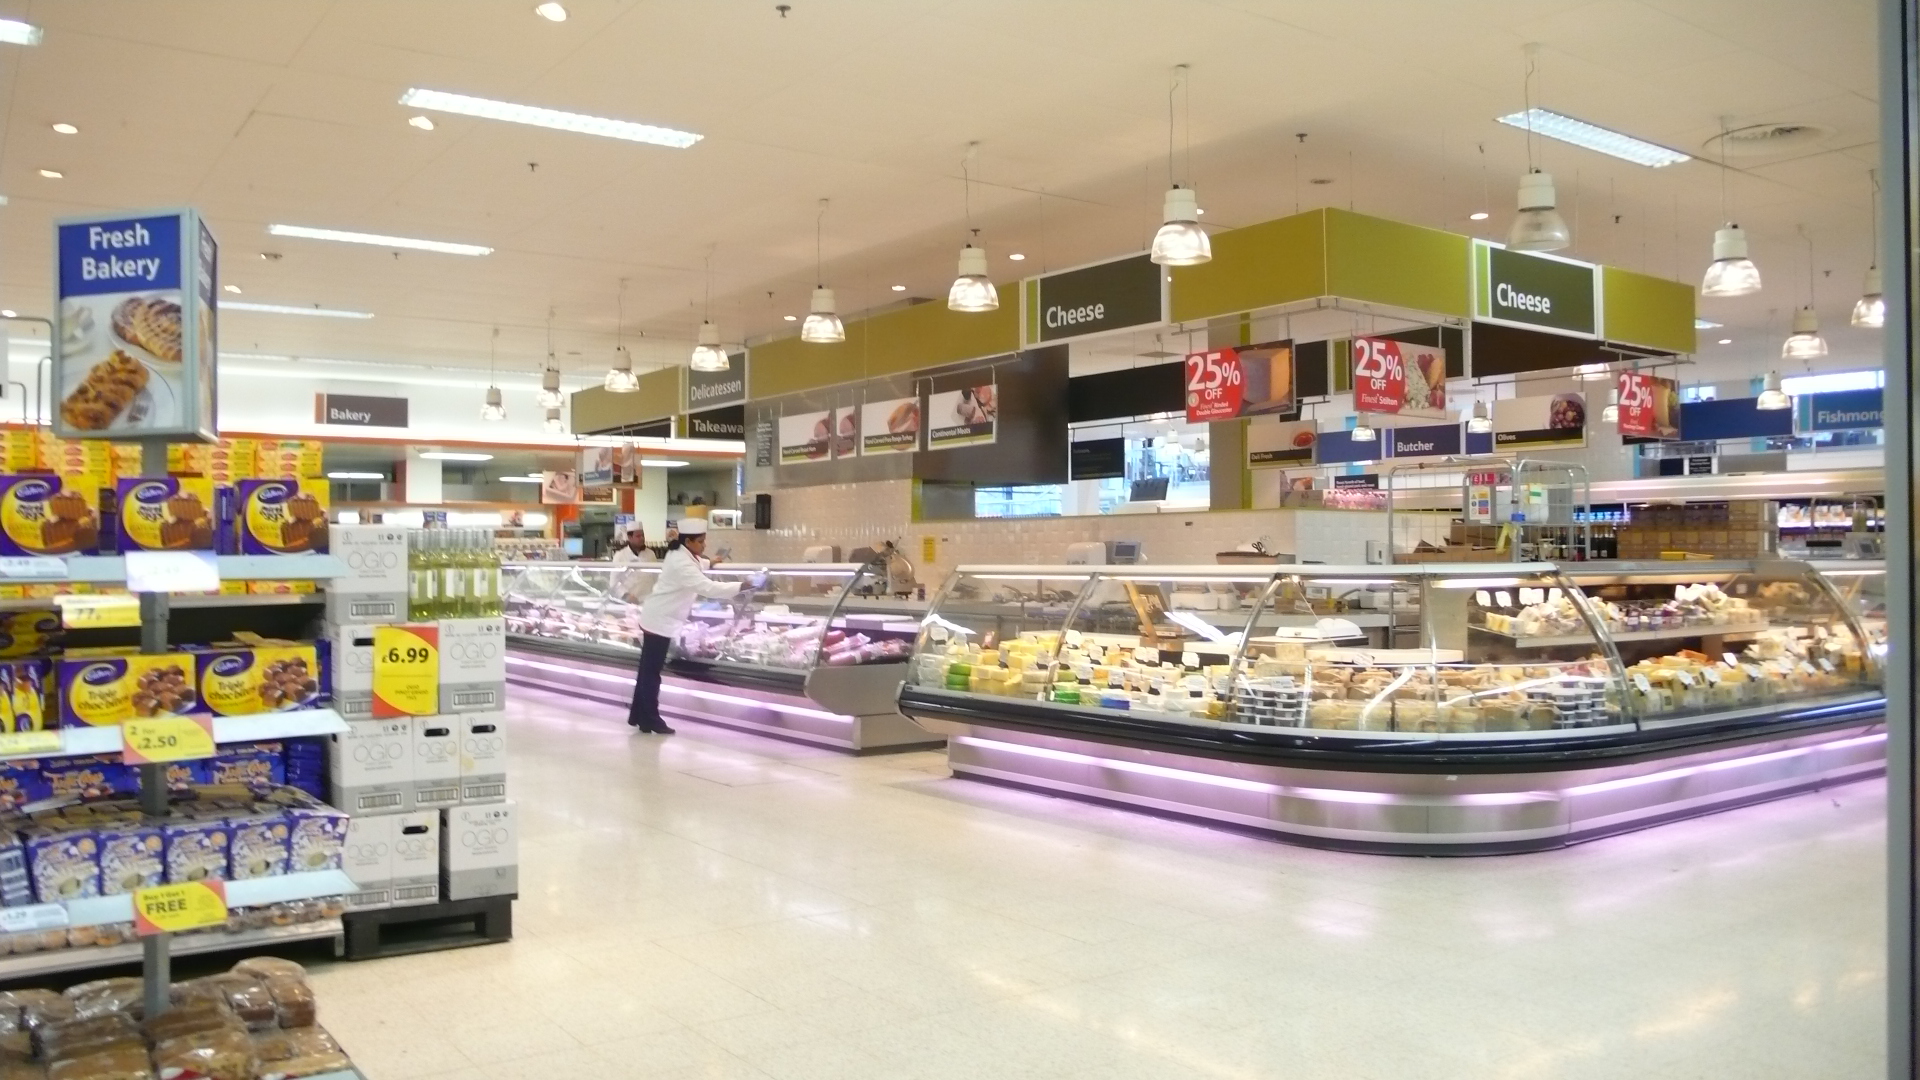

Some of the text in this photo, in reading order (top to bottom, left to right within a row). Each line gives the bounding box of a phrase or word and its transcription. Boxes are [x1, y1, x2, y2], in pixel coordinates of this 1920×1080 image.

[89, 222, 150, 250] Fresh
[81, 255, 160, 281] Bakery
[1496, 283, 1551, 314] Cheese
[1046, 303, 1105, 328] Cheese
[1355, 338, 1403, 381] 25%
[1187, 352, 1241, 391] 25%
[690, 380, 742, 401] Delicatessen
[1370, 378, 1387, 390] OFF
[1619, 373, 1653, 409] 25%
[1205, 388, 1223, 400] OFF
[330, 408, 371, 424] Bakery
[1629, 407, 1641, 417] OFF
[692, 419, 744, 434] Takeawa
[932, 427, 971, 438] Continental Meats
[1497, 433, 1517, 441] Olives
[1396, 440, 1435, 452] Butcher
[347, 551, 398, 570] OGIO
[381, 647, 429, 664] £6.99
[450, 642, 497, 660] OGIO
[130, 726, 138, 736] 2
[137, 735, 178, 750] £2.50
[146, 899, 188, 915] FREE
